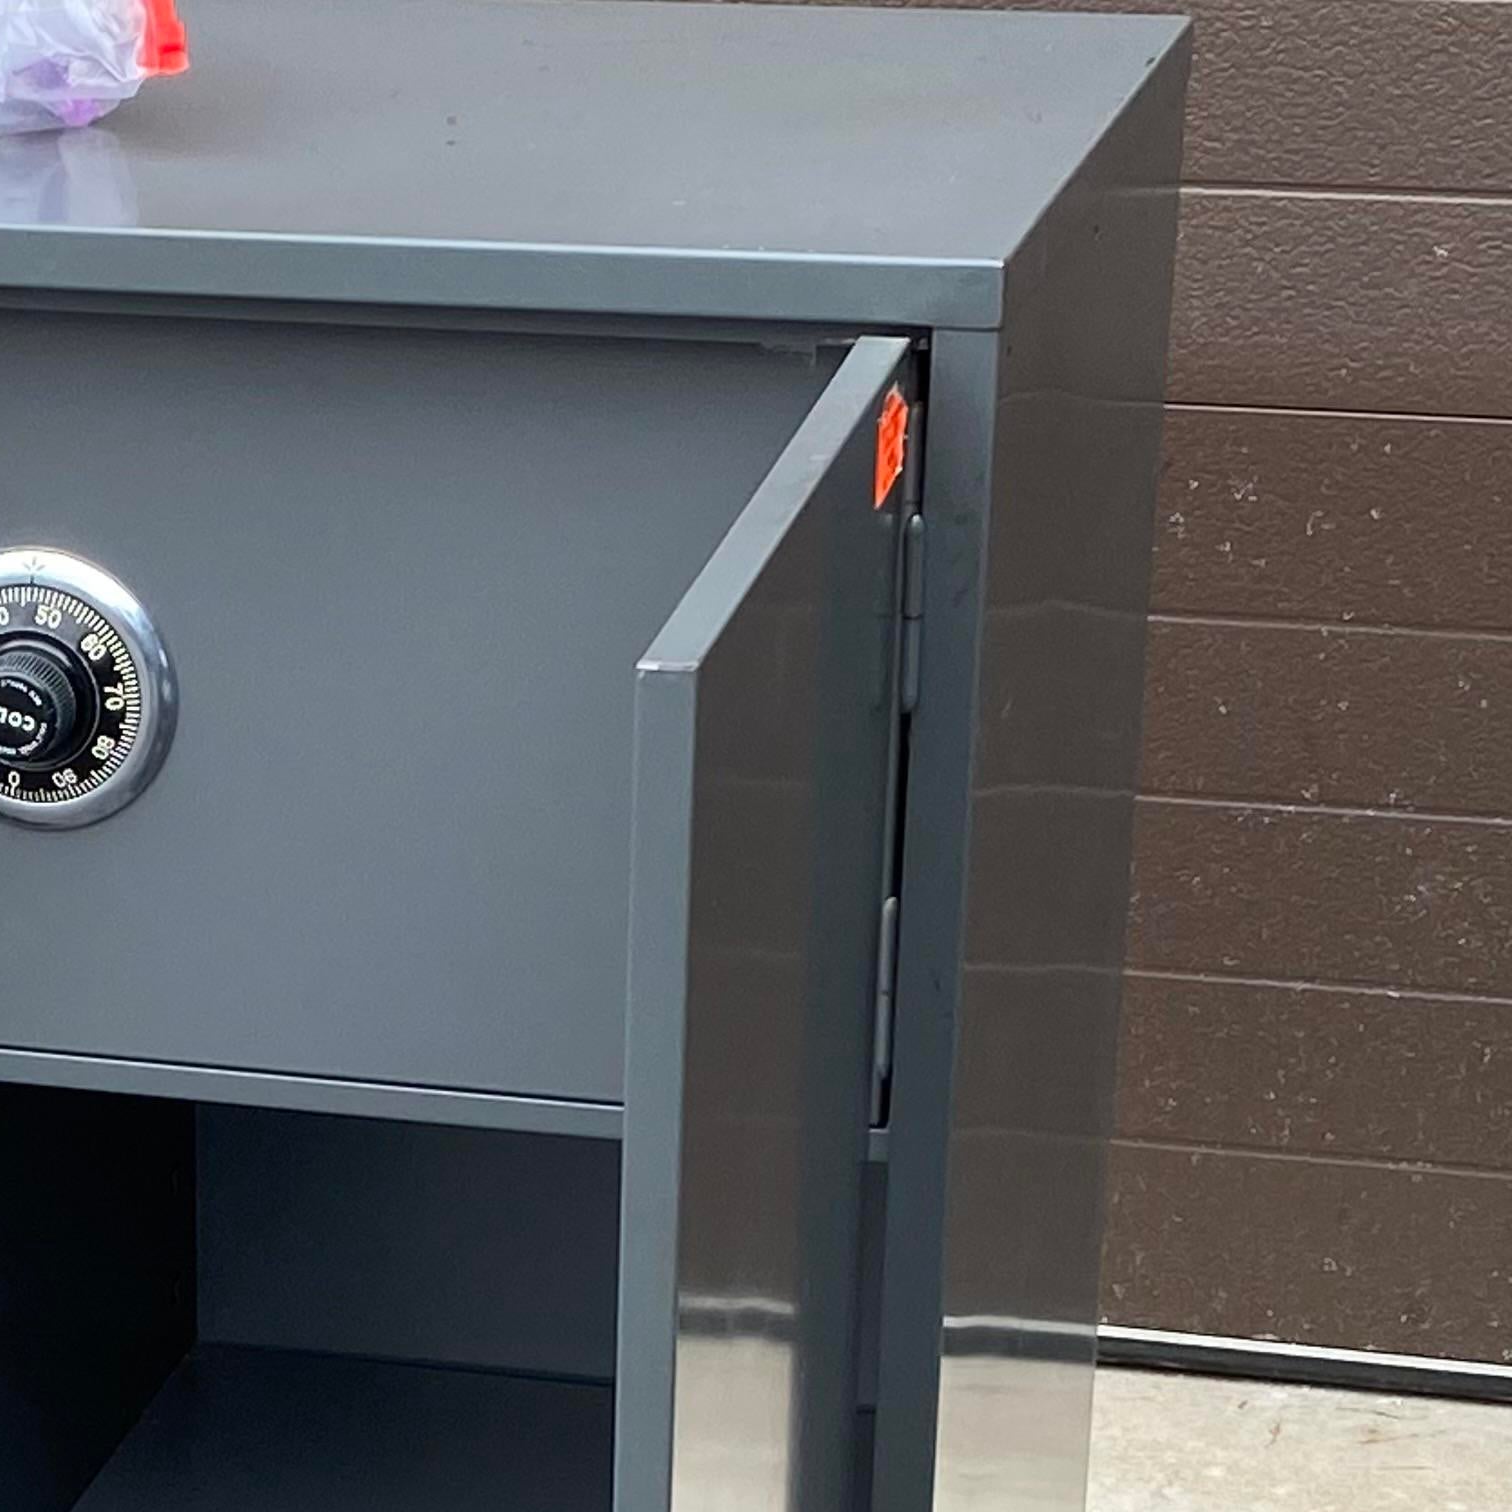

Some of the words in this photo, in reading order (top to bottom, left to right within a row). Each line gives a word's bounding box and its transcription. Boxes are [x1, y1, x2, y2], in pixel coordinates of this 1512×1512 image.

[35, 606, 62, 629] 50
[80, 634, 107, 661] 60
[103, 683, 125, 711] 70
[91, 736, 115, 760] 80
[52, 769, 78, 788] 90
